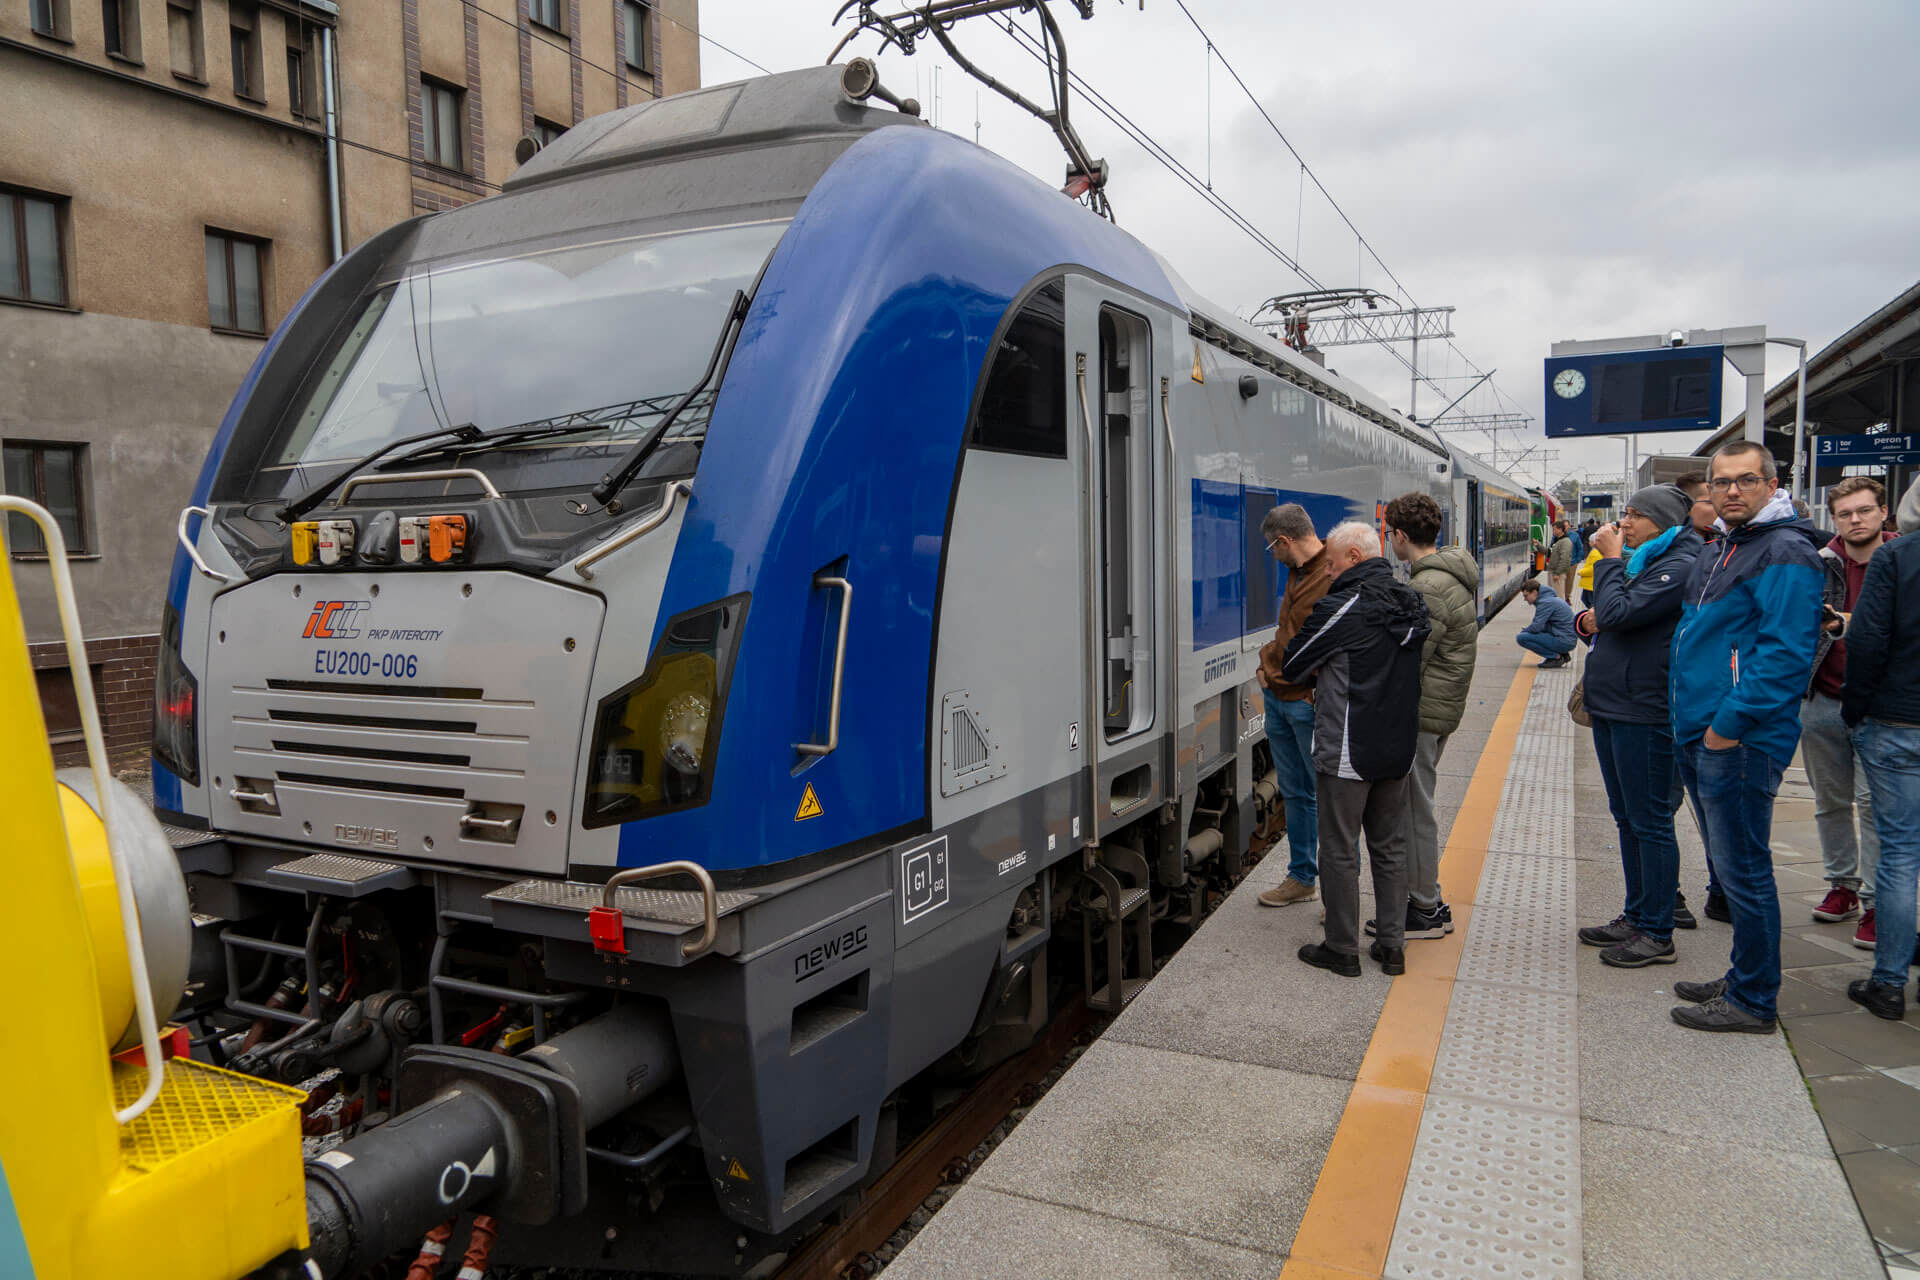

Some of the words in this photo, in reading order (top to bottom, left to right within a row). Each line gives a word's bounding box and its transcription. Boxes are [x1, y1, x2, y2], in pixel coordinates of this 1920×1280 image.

[1822, 440, 1832, 452] 3
[1874, 437, 1901, 446] peron
[1904, 436, 1911, 450] 1
[1897, 454, 1904, 462] C
[368, 629, 389, 639] PKP
[390, 629, 443, 641] INTERCITY
[315, 650, 418, 678] EU200-006
[1070, 725, 1077, 748] 2
[936, 852, 944, 864] G1
[914, 870, 925, 891] G1
[795, 925, 867, 975] newag
